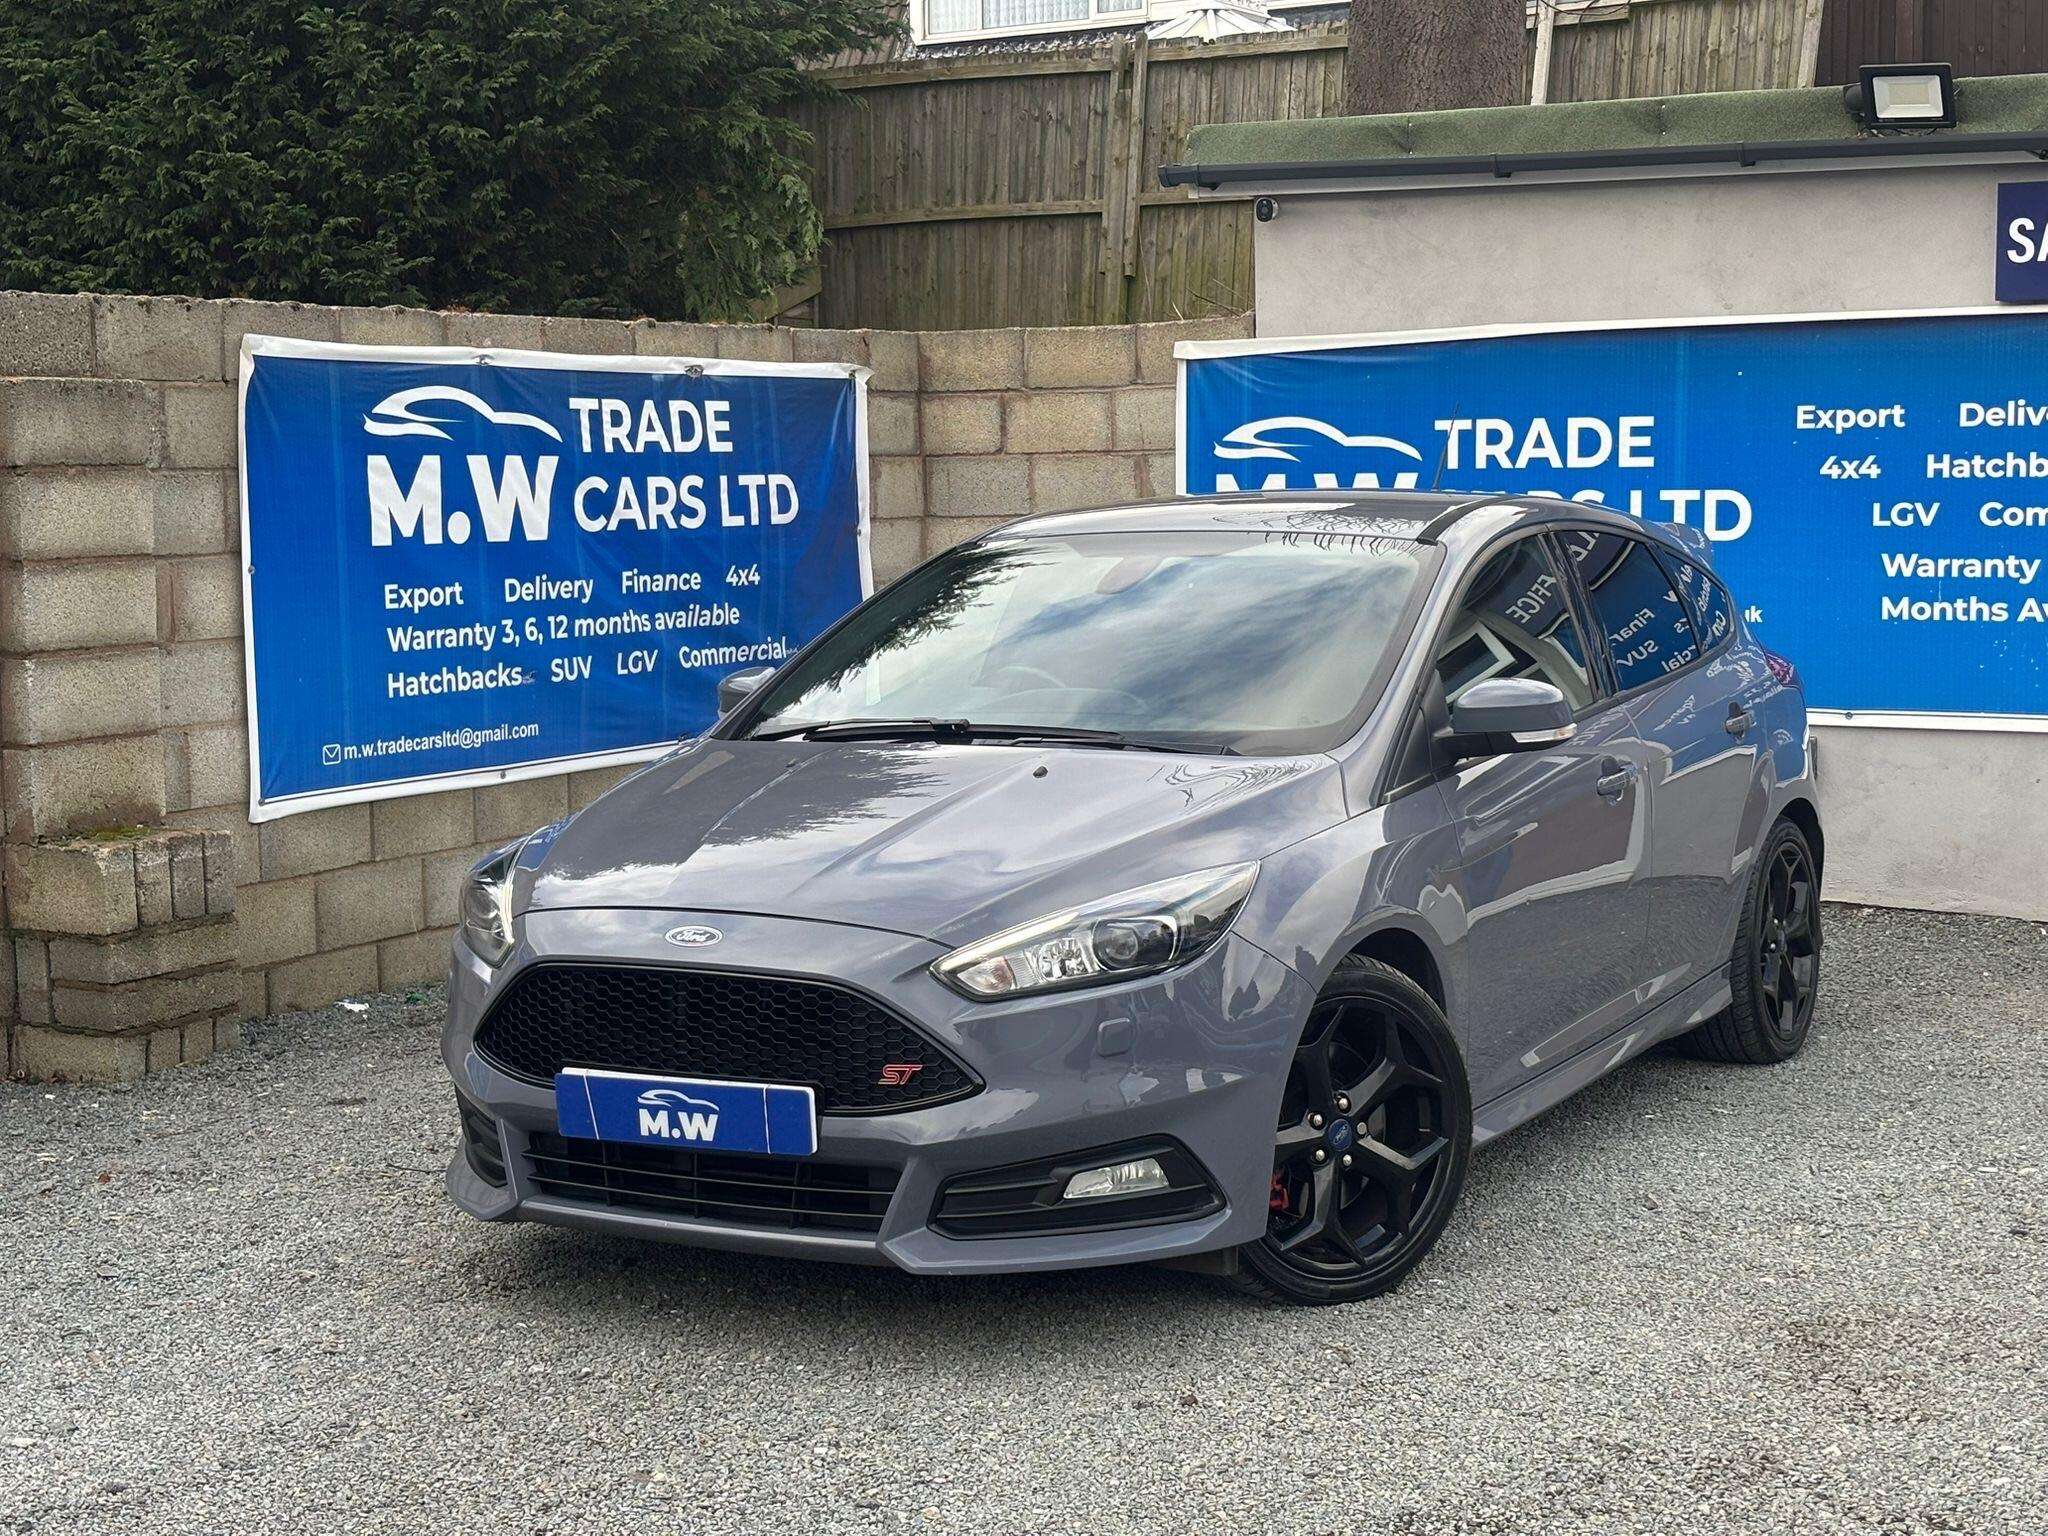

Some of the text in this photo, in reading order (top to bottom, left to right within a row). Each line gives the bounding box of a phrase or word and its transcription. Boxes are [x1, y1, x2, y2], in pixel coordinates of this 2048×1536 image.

[569, 398, 733, 452] TRADE
[1797, 399, 2048, 434] Export Deliv
[1435, 416, 1654, 469] TRADE
[1820, 451, 2048, 479] 4x4 Hatchb
[368, 455, 559, 546] M.W
[574, 474, 798, 532] CARS LTD
[1873, 503, 1940, 527] LGV
[385, 564, 760, 612] Export Delivery Finance 4x4
[1882, 555, 2041, 584] Warranty
[387, 603, 740, 651] Warranty 3, 6, 12 months available
[1882, 596, 2009, 622] Months
[388, 637, 787, 698] Hatchbacks SUV LGV Commercial
[344, 723, 539, 760] m.w.tradecarsltd@gmail.com
[878, 1064, 923, 1085] ST
[639, 1109, 719, 1141] M.W
